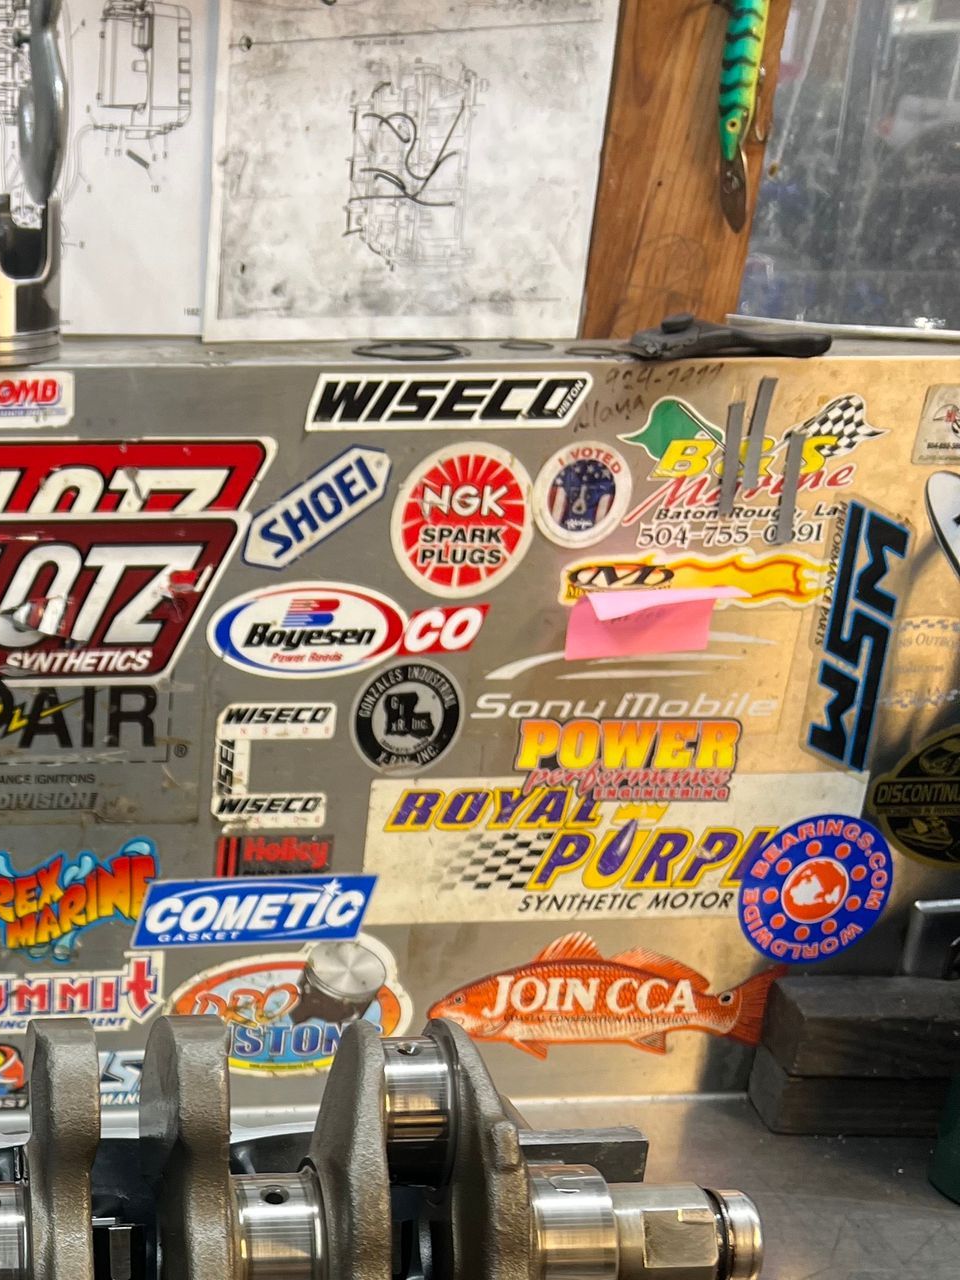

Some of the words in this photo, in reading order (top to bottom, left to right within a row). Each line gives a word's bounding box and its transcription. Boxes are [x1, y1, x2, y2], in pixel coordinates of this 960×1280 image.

[312, 378, 587, 423] WISECO
[555, 380, 585, 418] PISTON
[570, 447, 622, 475] VOTED
[259, 456, 378, 559] SHOEI
[421, 484, 509, 519] NGK
[655, 507, 719, 521] Baton
[726, 506, 802, 521] Roug,
[420, 527, 502, 545] SPARK
[823, 500, 849, 607] PERFORMANCE
[418, 548, 502, 566] PLUGS
[243, 622, 376, 651] Boyesen
[403, 607, 484, 653] CO
[807, 500, 910, 773] WSM
[814, 607, 831, 647] PARTS
[5, 649, 153, 674] SYNTHETICS
[270, 652, 304, 663] Power
[308, 651, 343, 662] Reeds
[358, 668, 403, 718] GONZALES
[470, 693, 606, 719] Sony
[614, 691, 774, 719] Mobile
[222, 706, 332, 725] WISECO
[515, 720, 740, 771] POWER
[34, 772, 96, 785] IGNITIONS
[523, 758, 731, 796] performance
[593, 786, 729, 800] ENGINEERING
[217, 797, 323, 814] WISECO
[385, 788, 604, 831] ROYAL
[243, 835, 330, 870] Holley
[750, 818, 889, 912] BEARINGS.COM
[5, 853, 158, 949] MARINE
[144, 889, 365, 934] COMETIC
[518, 893, 643, 913] SYNTHETIC
[647, 892, 735, 911] MOTOR
[157, 931, 241, 943] GASKET
[742, 886, 863, 960] WORLDWIDE
[482, 974, 600, 1019] JOIN
[606, 977, 698, 1015] CCA
